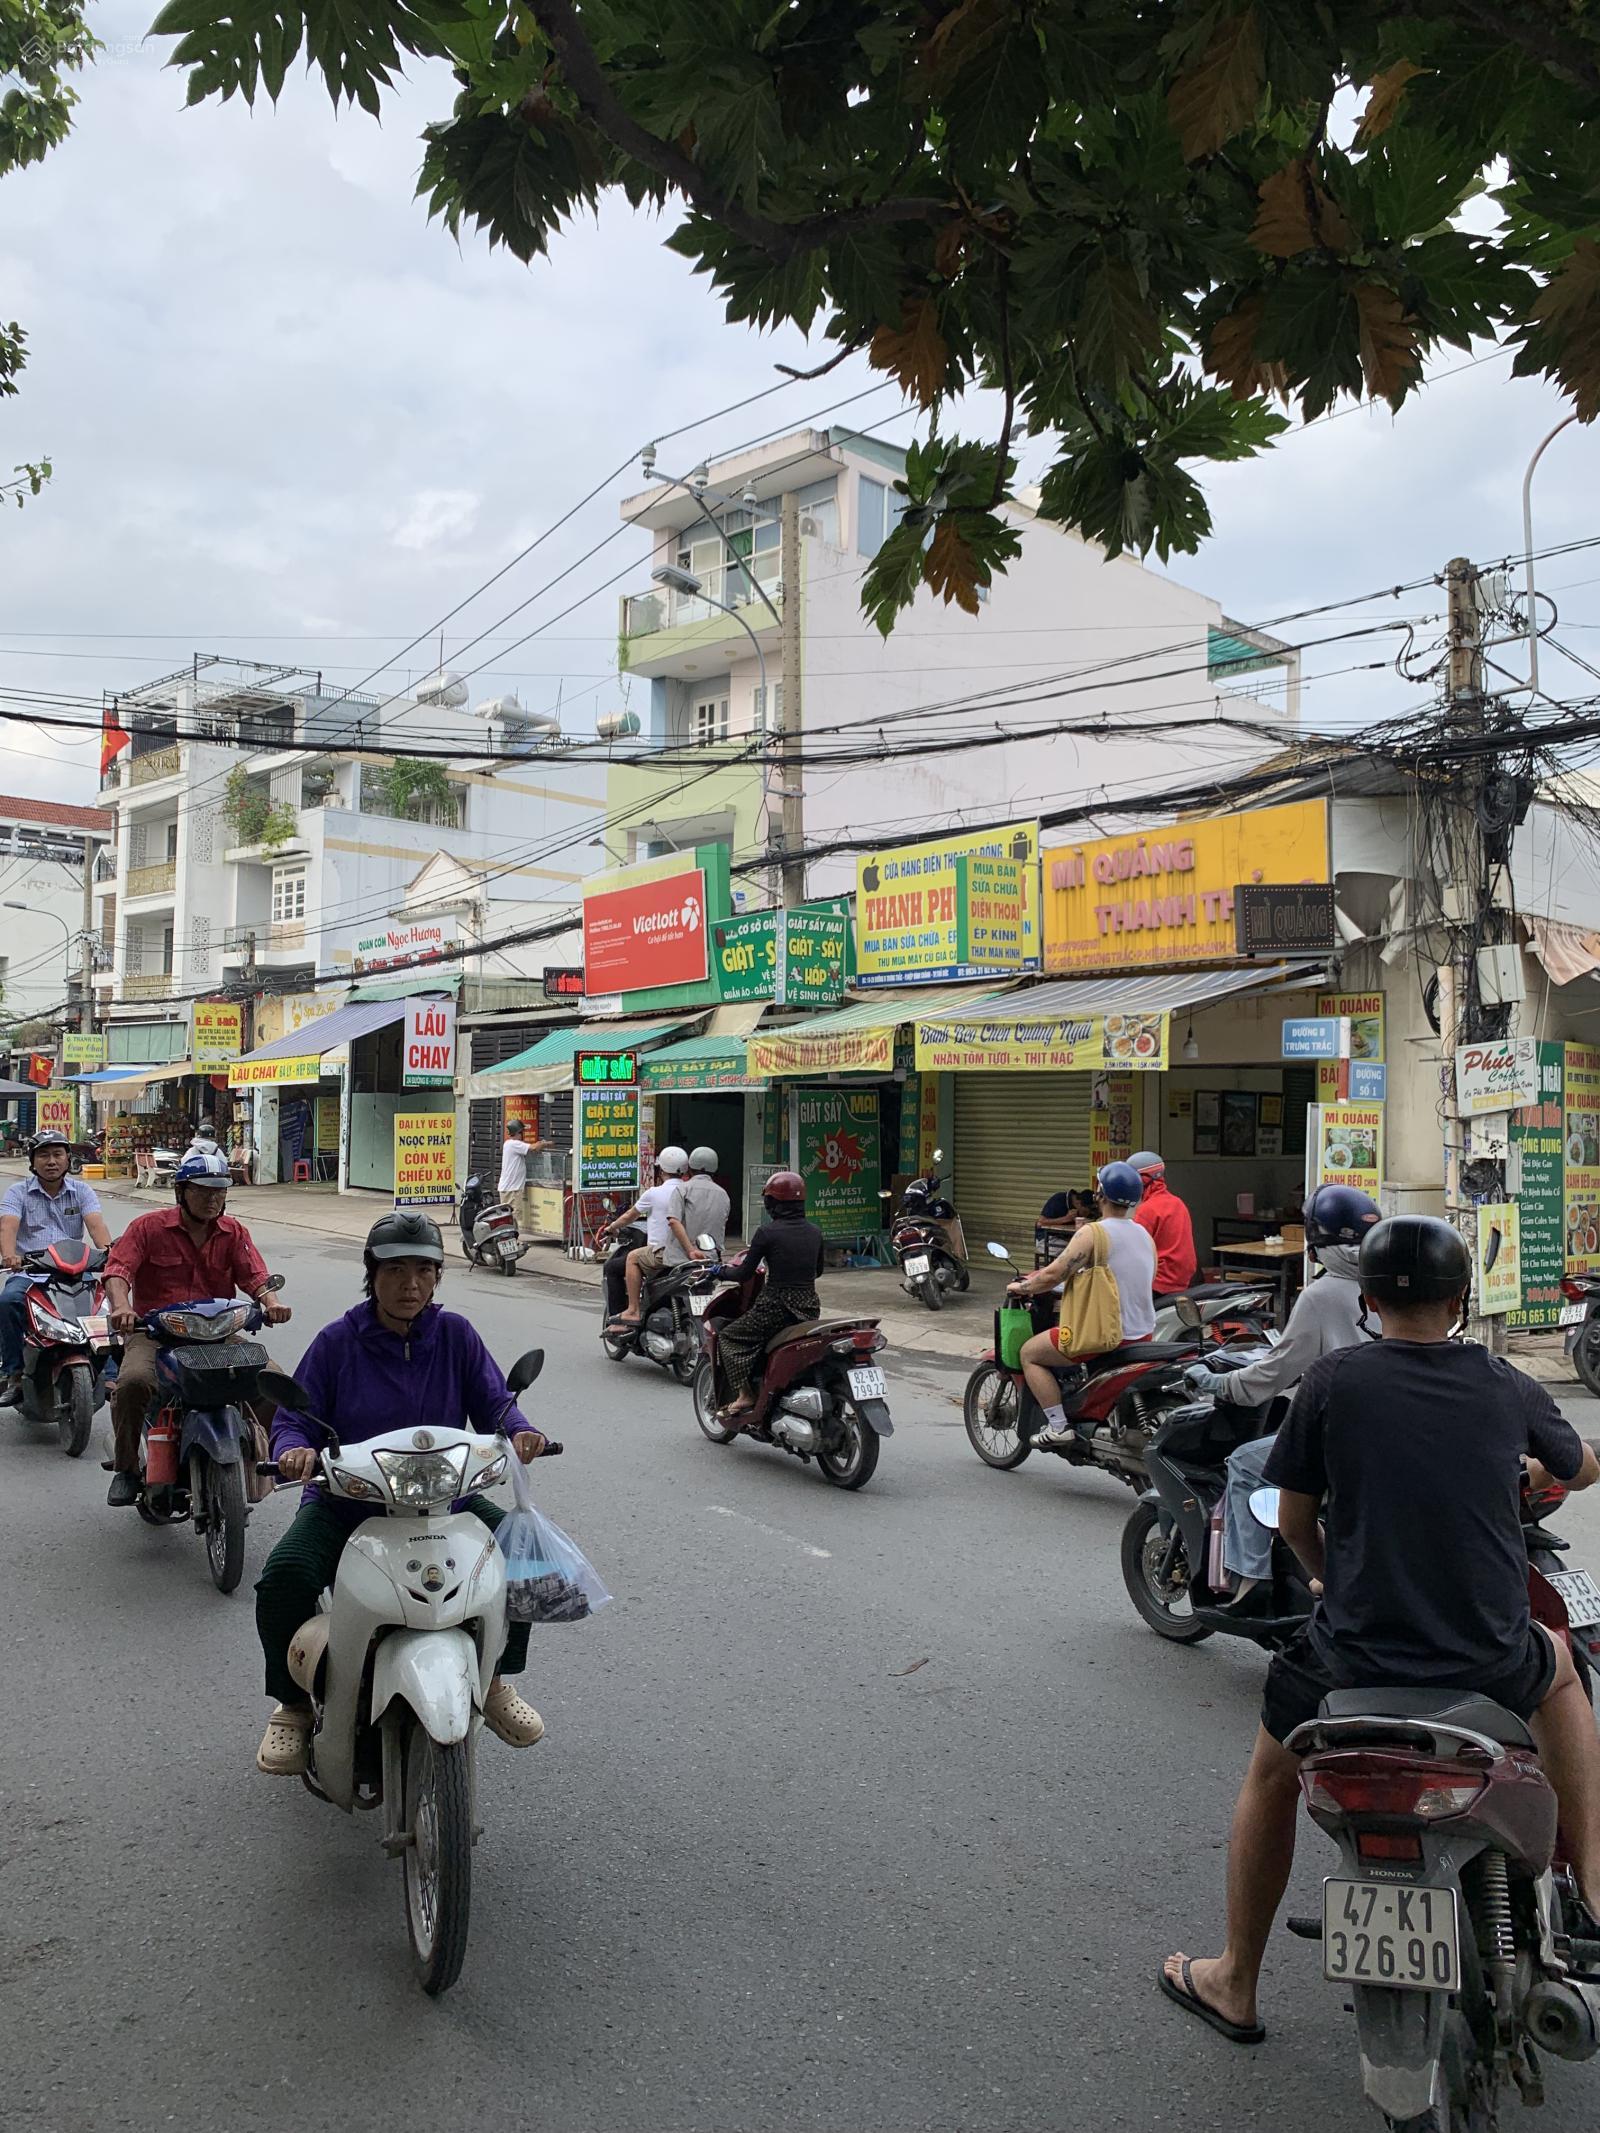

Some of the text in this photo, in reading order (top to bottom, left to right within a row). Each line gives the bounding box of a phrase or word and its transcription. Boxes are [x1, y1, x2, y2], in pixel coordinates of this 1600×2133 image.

[974, 863, 1016, 878] MUA BÁN
[1052, 838, 1195, 891] MÌ QUẢNG
[972, 878, 1018, 896] SỬA CHỮA
[866, 886, 957, 931] THANH PH
[994, 901, 1020, 925] THOẠI
[1094, 894, 1197, 937] THANH
[1274, 893, 1329, 942] QUẢNG
[633, 909, 679, 934] Vietlott
[738, 917, 761, 936] CƠ SỞ
[788, 915, 844, 934] GIẶT SẤY MAI
[387, 931, 408, 950] Ngọc
[410, 927, 441, 943] Hương
[864, 939, 880, 954] MUA
[788, 936, 844, 960] GIẶT SẤY
[722, 940, 755, 977] GIẶT
[805, 963, 828, 986] HẤP
[724, 982, 767, 1000] QUẦN ÁO GẤU
[788, 988, 798, 1003] VỆ
[800, 990, 820, 1002] SINH
[1320, 993, 1381, 1017] MÌ QUẢNG
[415, 1003, 446, 1037] LẨU
[920, 1023, 949, 1047] Bánh
[1014, 1020, 1056, 1047] Quảng
[1291, 1026, 1317, 1038] ĐƯỜNG
[1285, 1039, 1332, 1052] TRƯNG TRẮC
[409, 1044, 451, 1070] CHAY
[963, 1050, 984, 1065] TÔM
[1024, 1051, 1048, 1068] THỊT
[1050, 1051, 1074, 1068] NẠC
[1464, 1045, 1516, 1076] Phúc
[252, 1064, 278, 1080] CHAY
[581, 1053, 634, 1084] GIẶT SẤY
[649, 1059, 737, 1075] GIẶT SẤY MAI
[1355, 1066, 1383, 1080] ĐƯỜNG
[1488, 1067, 1526, 1084] Coffee
[1359, 1083, 1377, 1097] SỐ 1
[42, 1099, 70, 1121] CƠM
[586, 1101, 635, 1121] GIẶT SẤY
[800, 1098, 821, 1128] GIẶT
[823, 1094, 843, 1123] SẤY
[850, 1095, 877, 1114] MAI
[1325, 1108, 1379, 1126] MÌ QUẢNG
[399, 1116, 453, 1131] ĐẠI LÝ SỐ
[585, 1121, 636, 1139] HẤP VEST
[399, 1131, 453, 1149] NGỌC PHÁT
[1540, 1137, 1562, 1157] DỤNG
[582, 1142, 595, 1161] VỆ
[596, 1143, 617, 1158] SINH
[581, 1160, 598, 1171] GẤU
[608, 1170, 632, 1180] TOPPER
[415, 1183, 426, 1195] SỐ
[818, 1186, 862, 1198] HẤP VEST
[815, 1198, 846, 1208] VỆ SINH
[1506, 1308, 1545, 1326] 0979 665
[854, 1371, 881, 1384] 82-B1
[409, 1534, 448, 1543] HONDA
[1369, 1869, 1415, 1880] HONDA
[1343, 1885, 1433, 1934] 47-K1
[1331, 1931, 1450, 1984] 326.90
